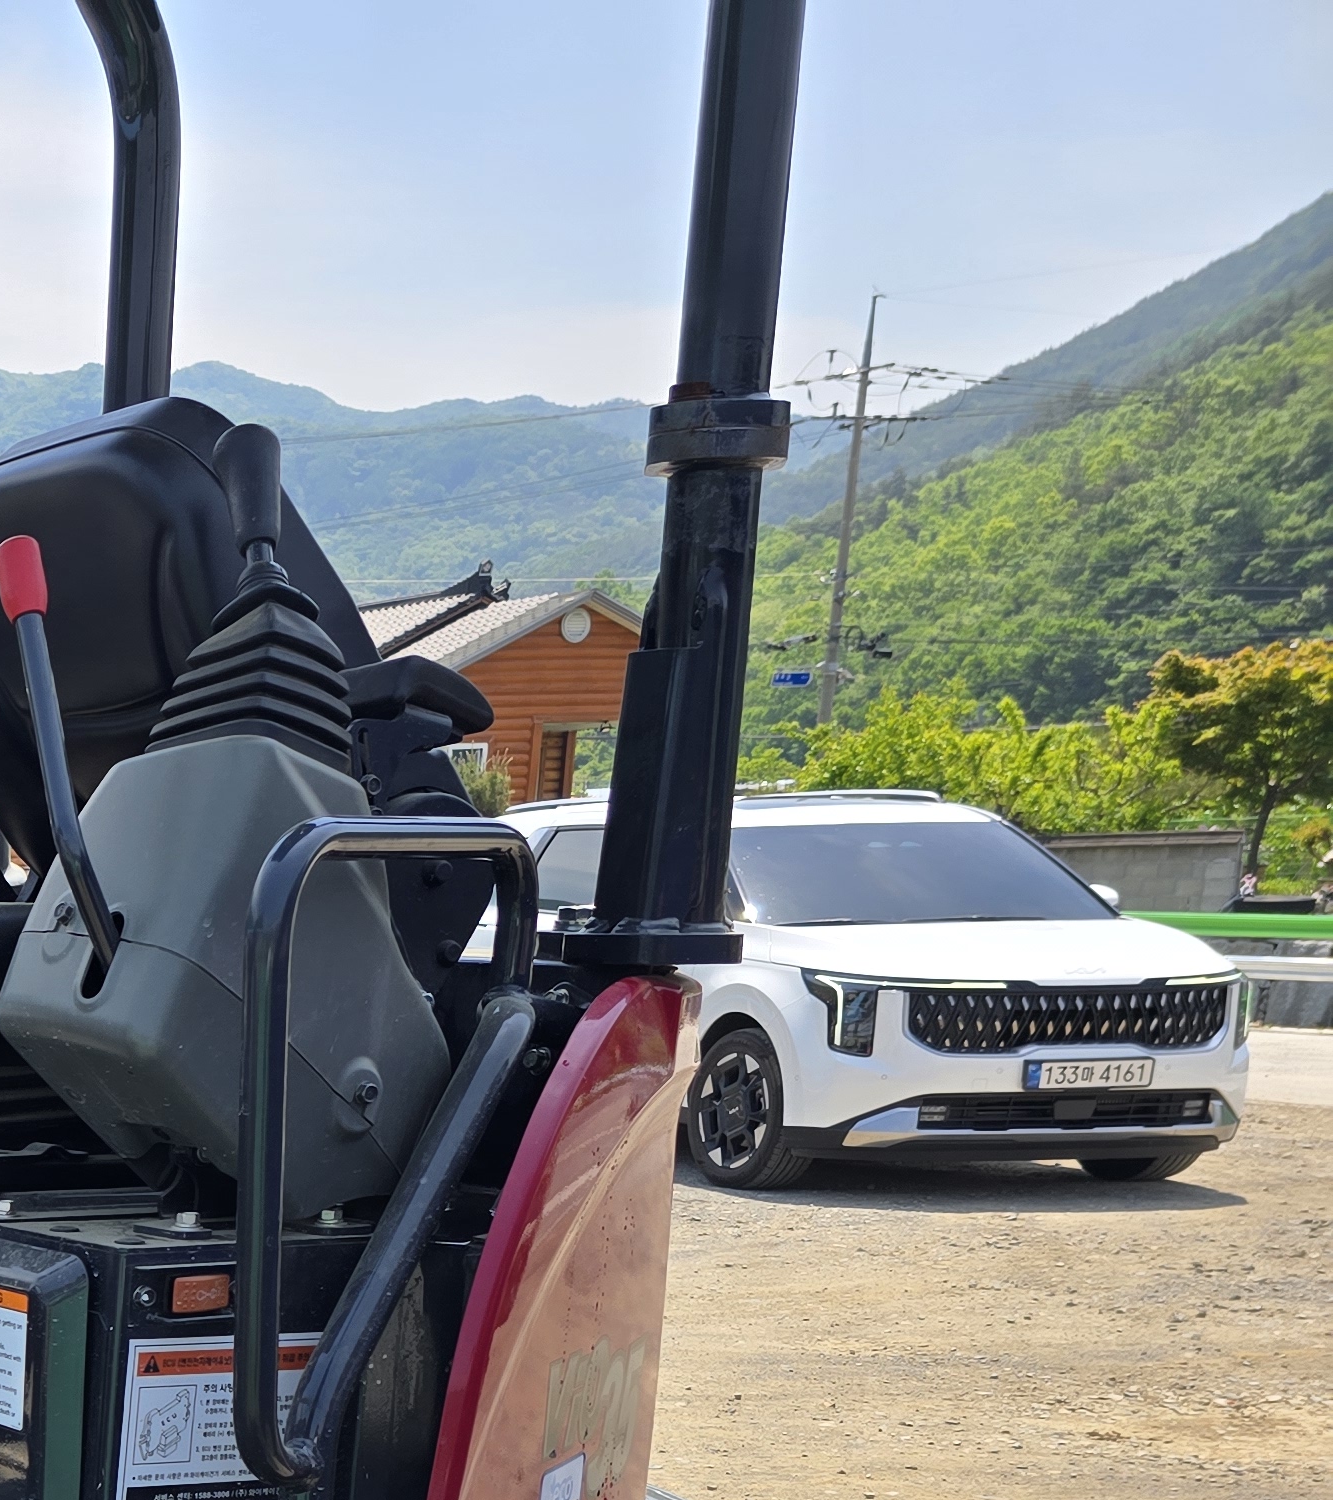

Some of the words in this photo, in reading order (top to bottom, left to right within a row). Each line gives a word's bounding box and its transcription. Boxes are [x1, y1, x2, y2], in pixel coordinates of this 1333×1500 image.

[1044, 1065, 1095, 1085] 133마
[1099, 1063, 1146, 1083] 4161
[204, 1384, 218, 1393] 주의
[194, 1491, 230, 1499] 1588-3806
